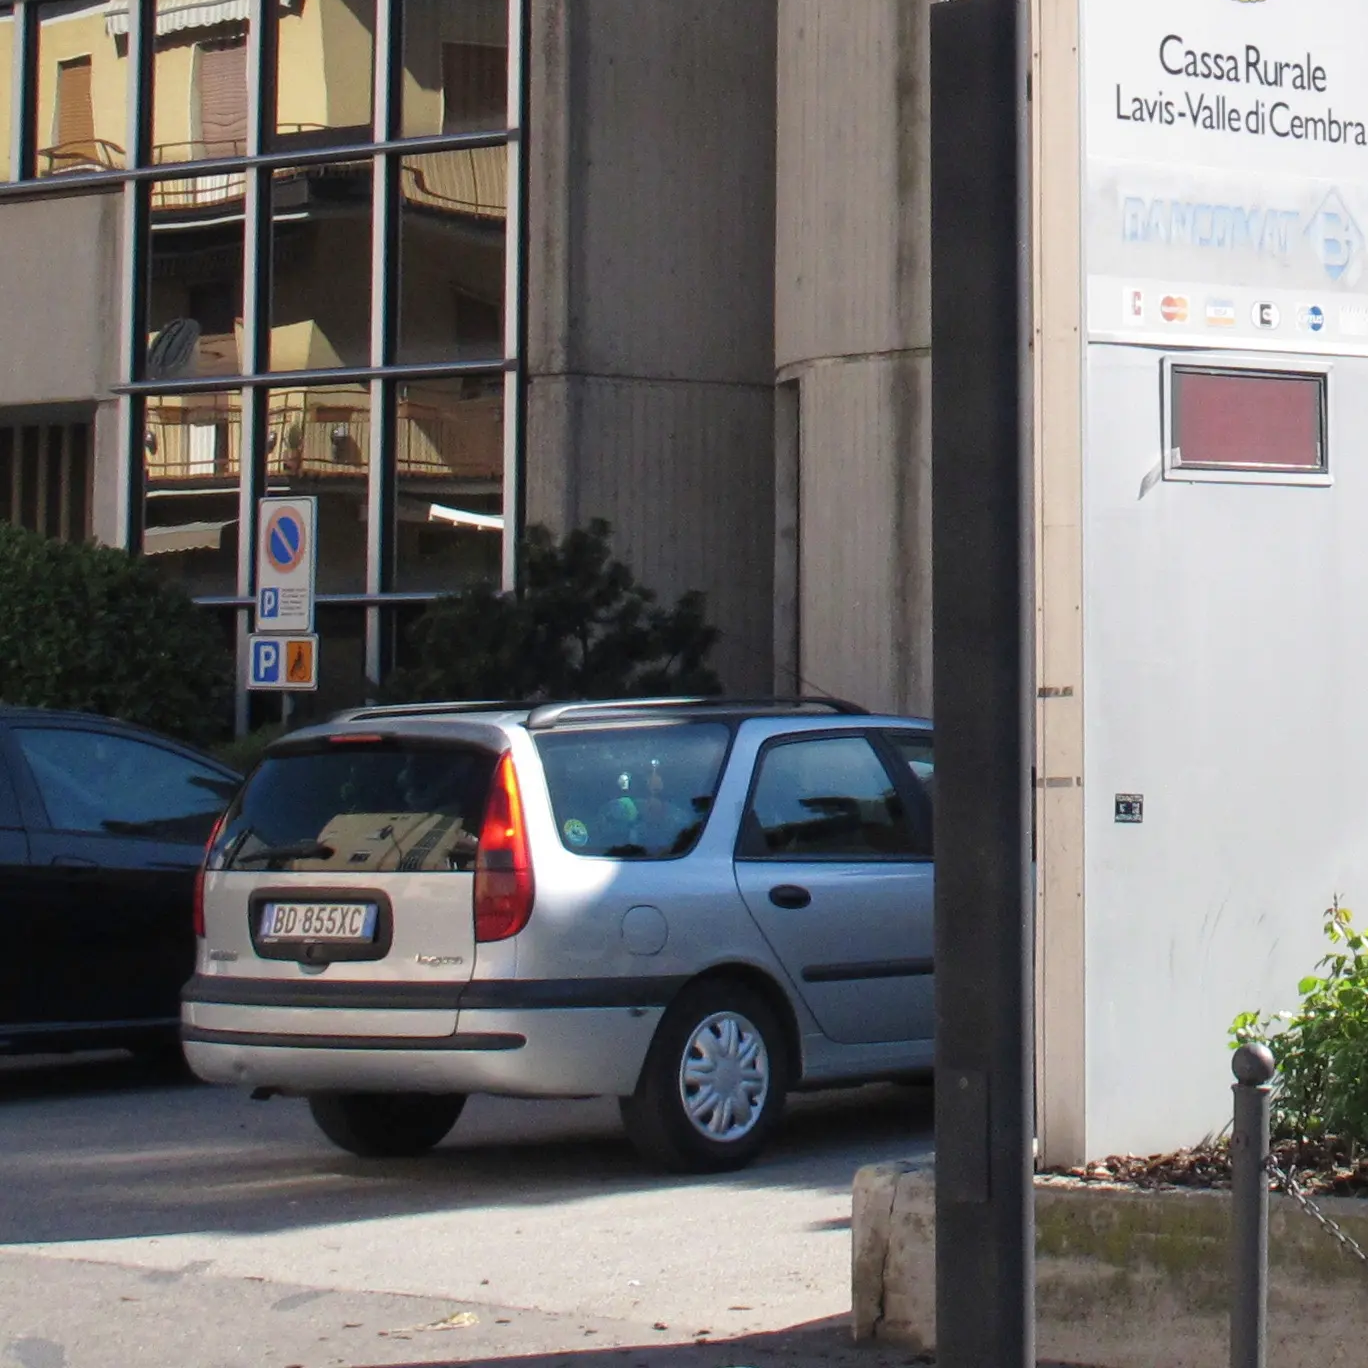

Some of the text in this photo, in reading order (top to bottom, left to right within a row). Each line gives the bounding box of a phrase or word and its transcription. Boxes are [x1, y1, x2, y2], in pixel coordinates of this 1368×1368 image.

[1159, 34, 1327, 92] Cassa Rurale
[1245, 99, 1265, 135] di
[1269, 101, 1367, 146] Cembra
[263, 590, 275, 616] P
[258, 644, 277, 679] P
[273, 906, 363, 935] BD 855XC
